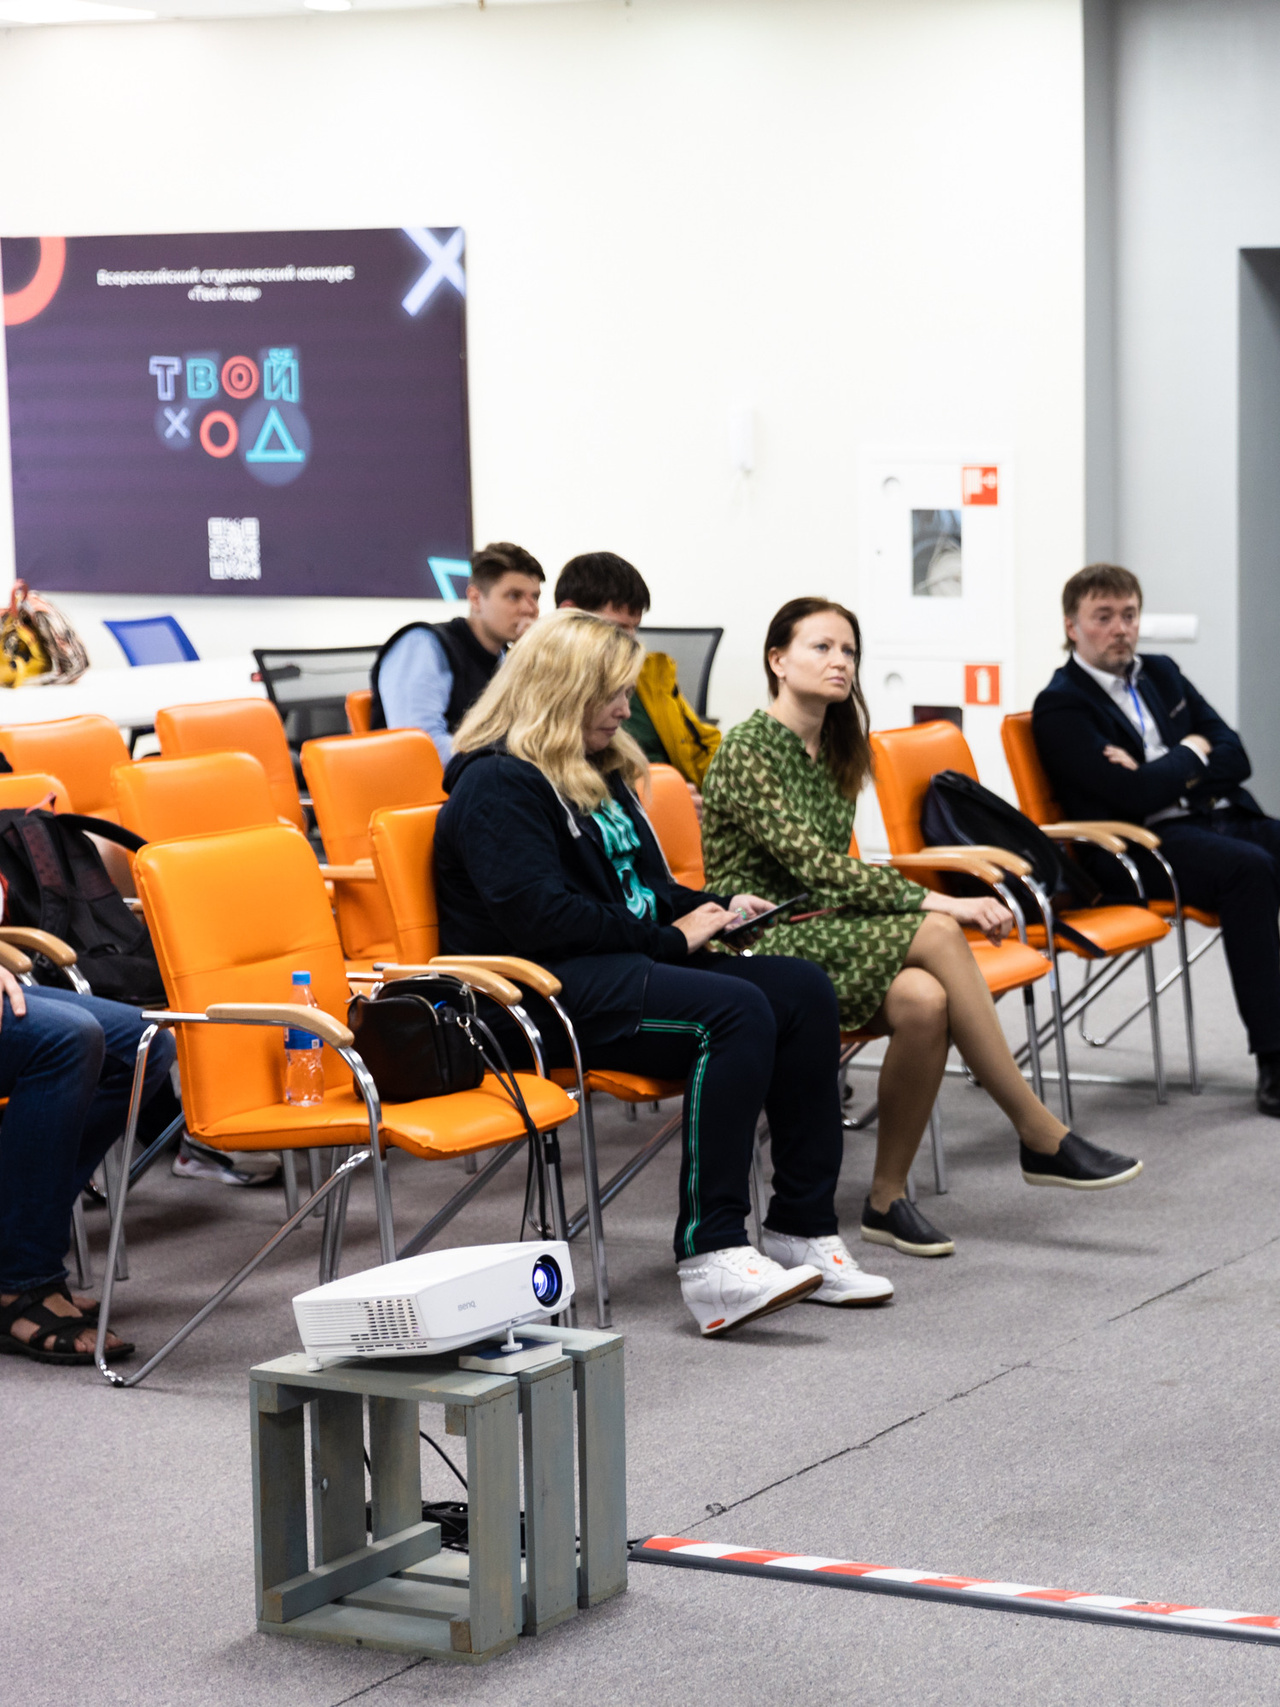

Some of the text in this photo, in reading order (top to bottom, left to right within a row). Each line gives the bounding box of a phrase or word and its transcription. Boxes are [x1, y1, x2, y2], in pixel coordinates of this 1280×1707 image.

[97, 264, 355, 287] Всероссийский студенческий конкурс
[149, 347, 299, 403] ТВОЙ
